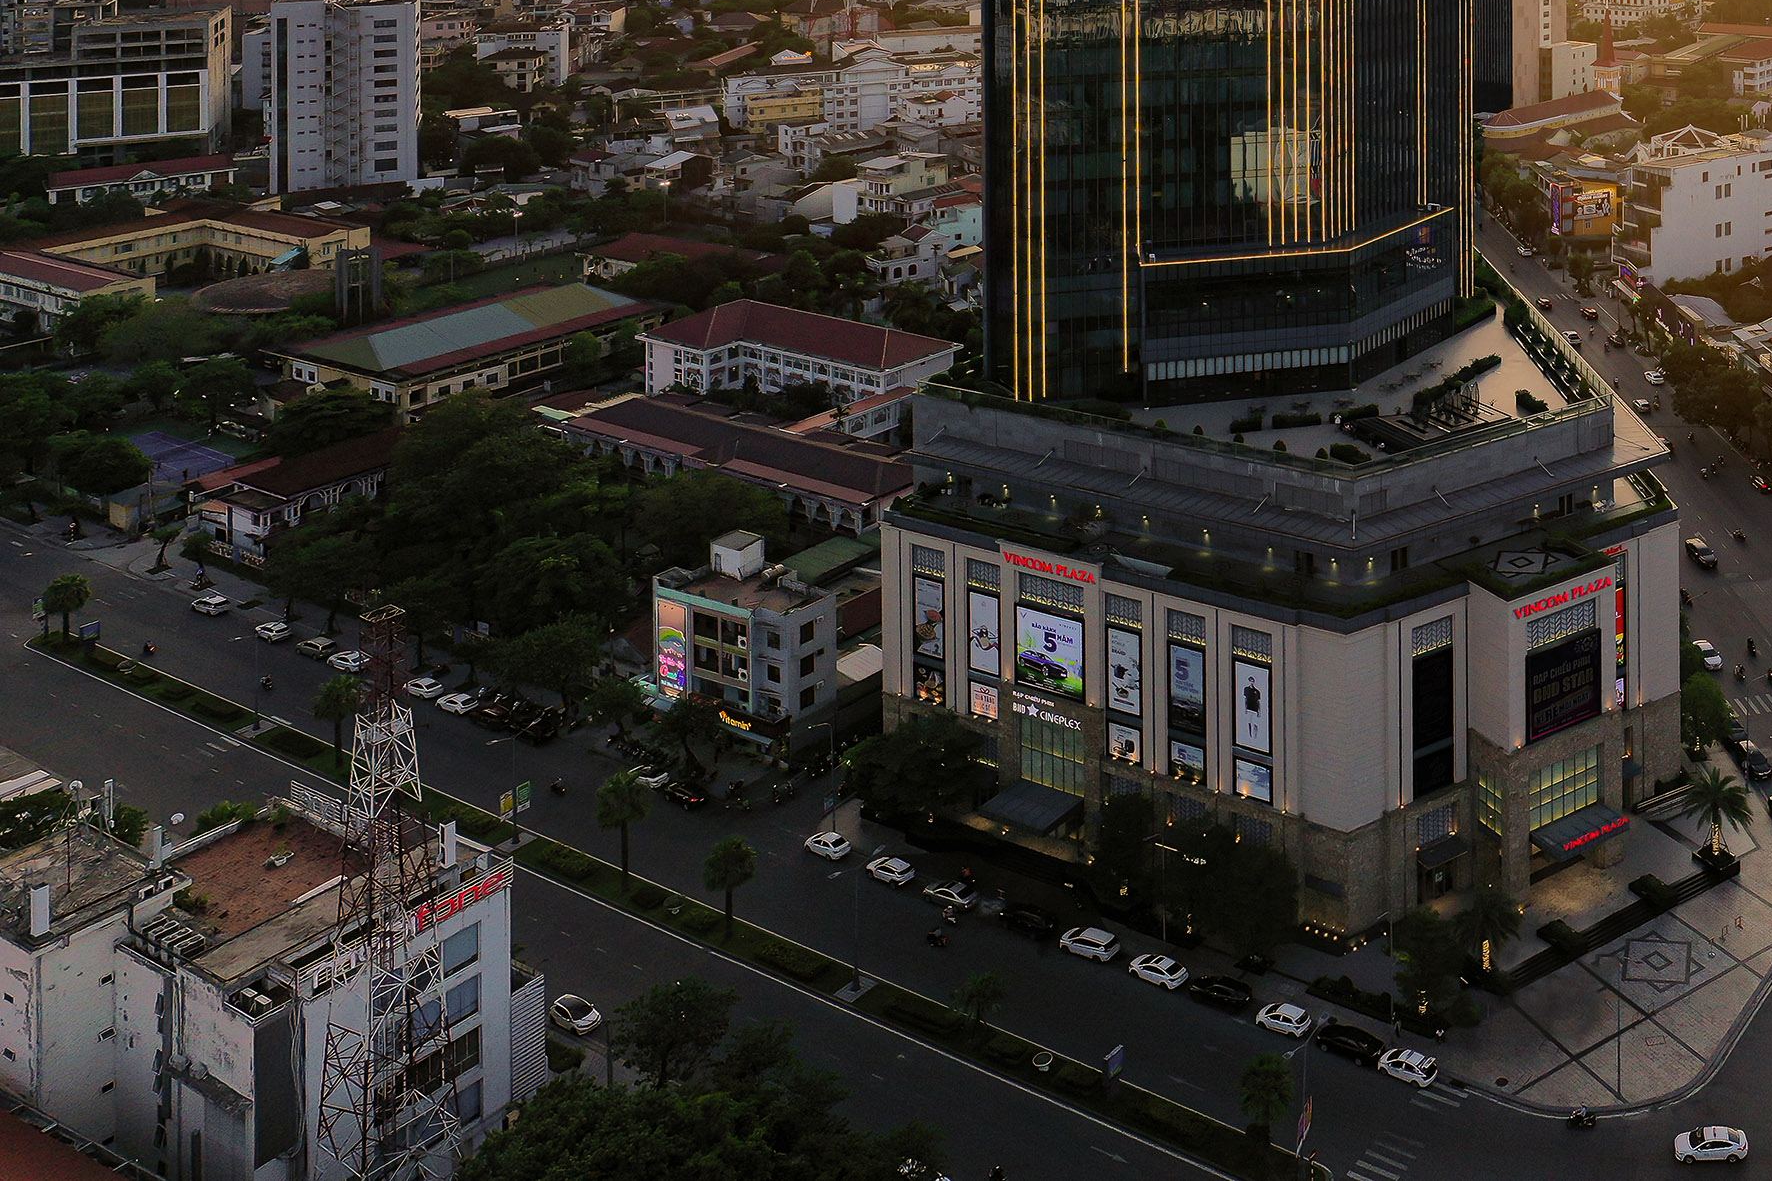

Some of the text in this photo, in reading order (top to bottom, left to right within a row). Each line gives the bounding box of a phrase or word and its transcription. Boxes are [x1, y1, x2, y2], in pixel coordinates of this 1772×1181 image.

[1002, 551, 1096, 584] VINCOM PLAZA
[1513, 577, 1612, 618] VINCOM PLAZA
[1043, 632, 1057, 652] 5
[1174, 659, 1189, 681] 5
[1562, 667, 1595, 692] STAR
[1040, 710, 1082, 732] CINEPLEX
